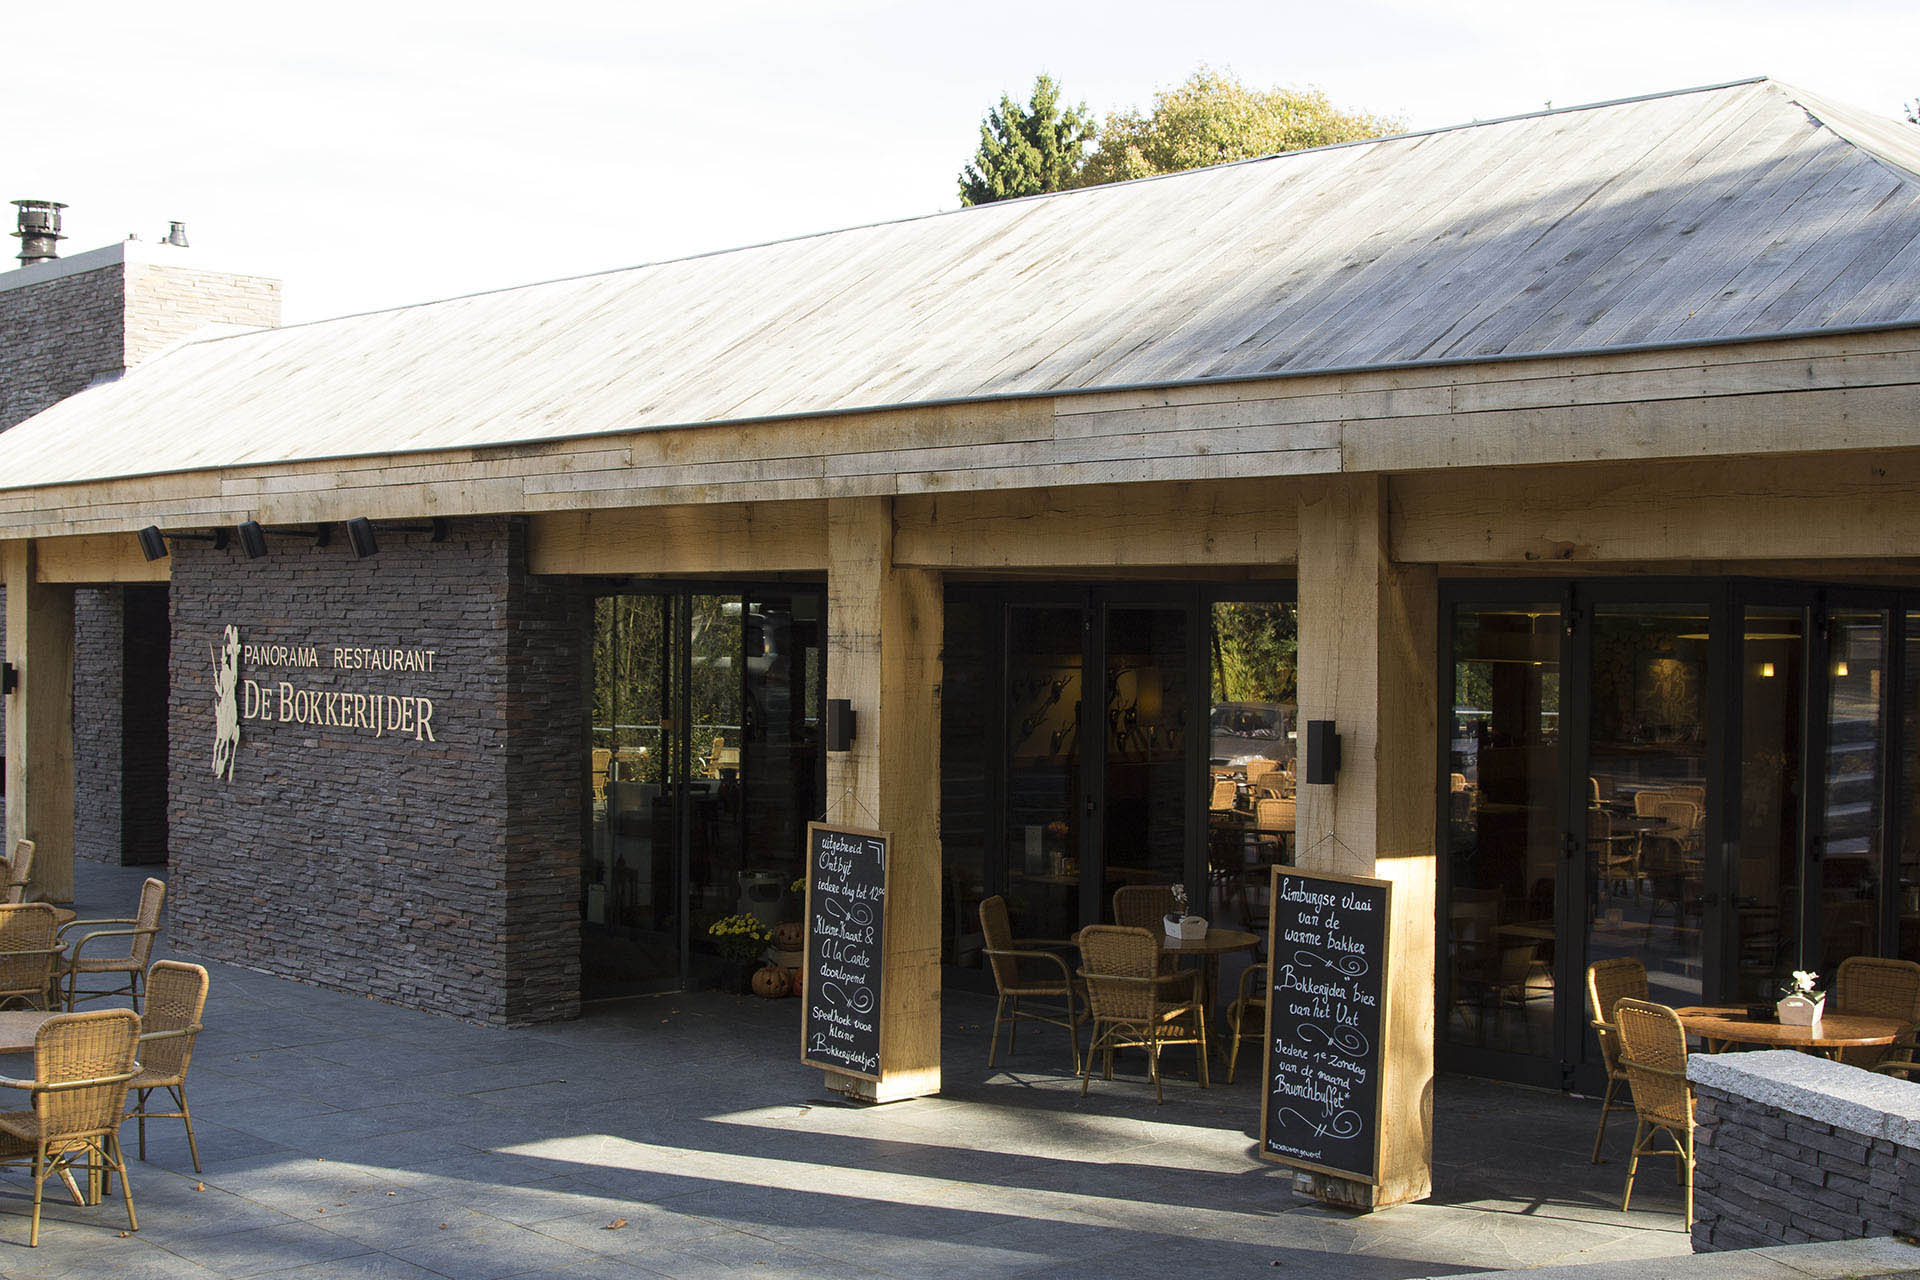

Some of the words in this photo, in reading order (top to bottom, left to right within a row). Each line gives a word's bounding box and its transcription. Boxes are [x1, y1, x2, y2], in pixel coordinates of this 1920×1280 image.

[244, 645, 319, 667] PANORAMA
[334, 647, 435, 672] RESTAURANT
[821, 834, 863, 856] uitgebreid
[842, 881, 855, 903] dag
[856, 883, 867, 899] tot
[1280, 877, 1336, 913] Limburgse
[1342, 892, 1373, 912] vlaai
[1298, 911, 1319, 926] van
[1325, 911, 1341, 930] de
[865, 926, 875, 945] &
[1284, 928, 1322, 946] warme
[1327, 931, 1366, 955] bakker
[832, 941, 842, 963] la
[843, 944, 871, 968] Carte
[820, 963, 866, 986] doorlopend
[1353, 982, 1376, 1007] bier
[1289, 1004, 1311, 1017] van
[1312, 997, 1331, 1018] het
[1336, 1004, 1359, 1027] Vat
[854, 1019, 873, 1032] voor
[1279, 1061, 1298, 1074] van
[1301, 1063, 1314, 1079] de
[1317, 1069, 1351, 1090] maand
[1327, 1054, 1367, 1084] Zondag
